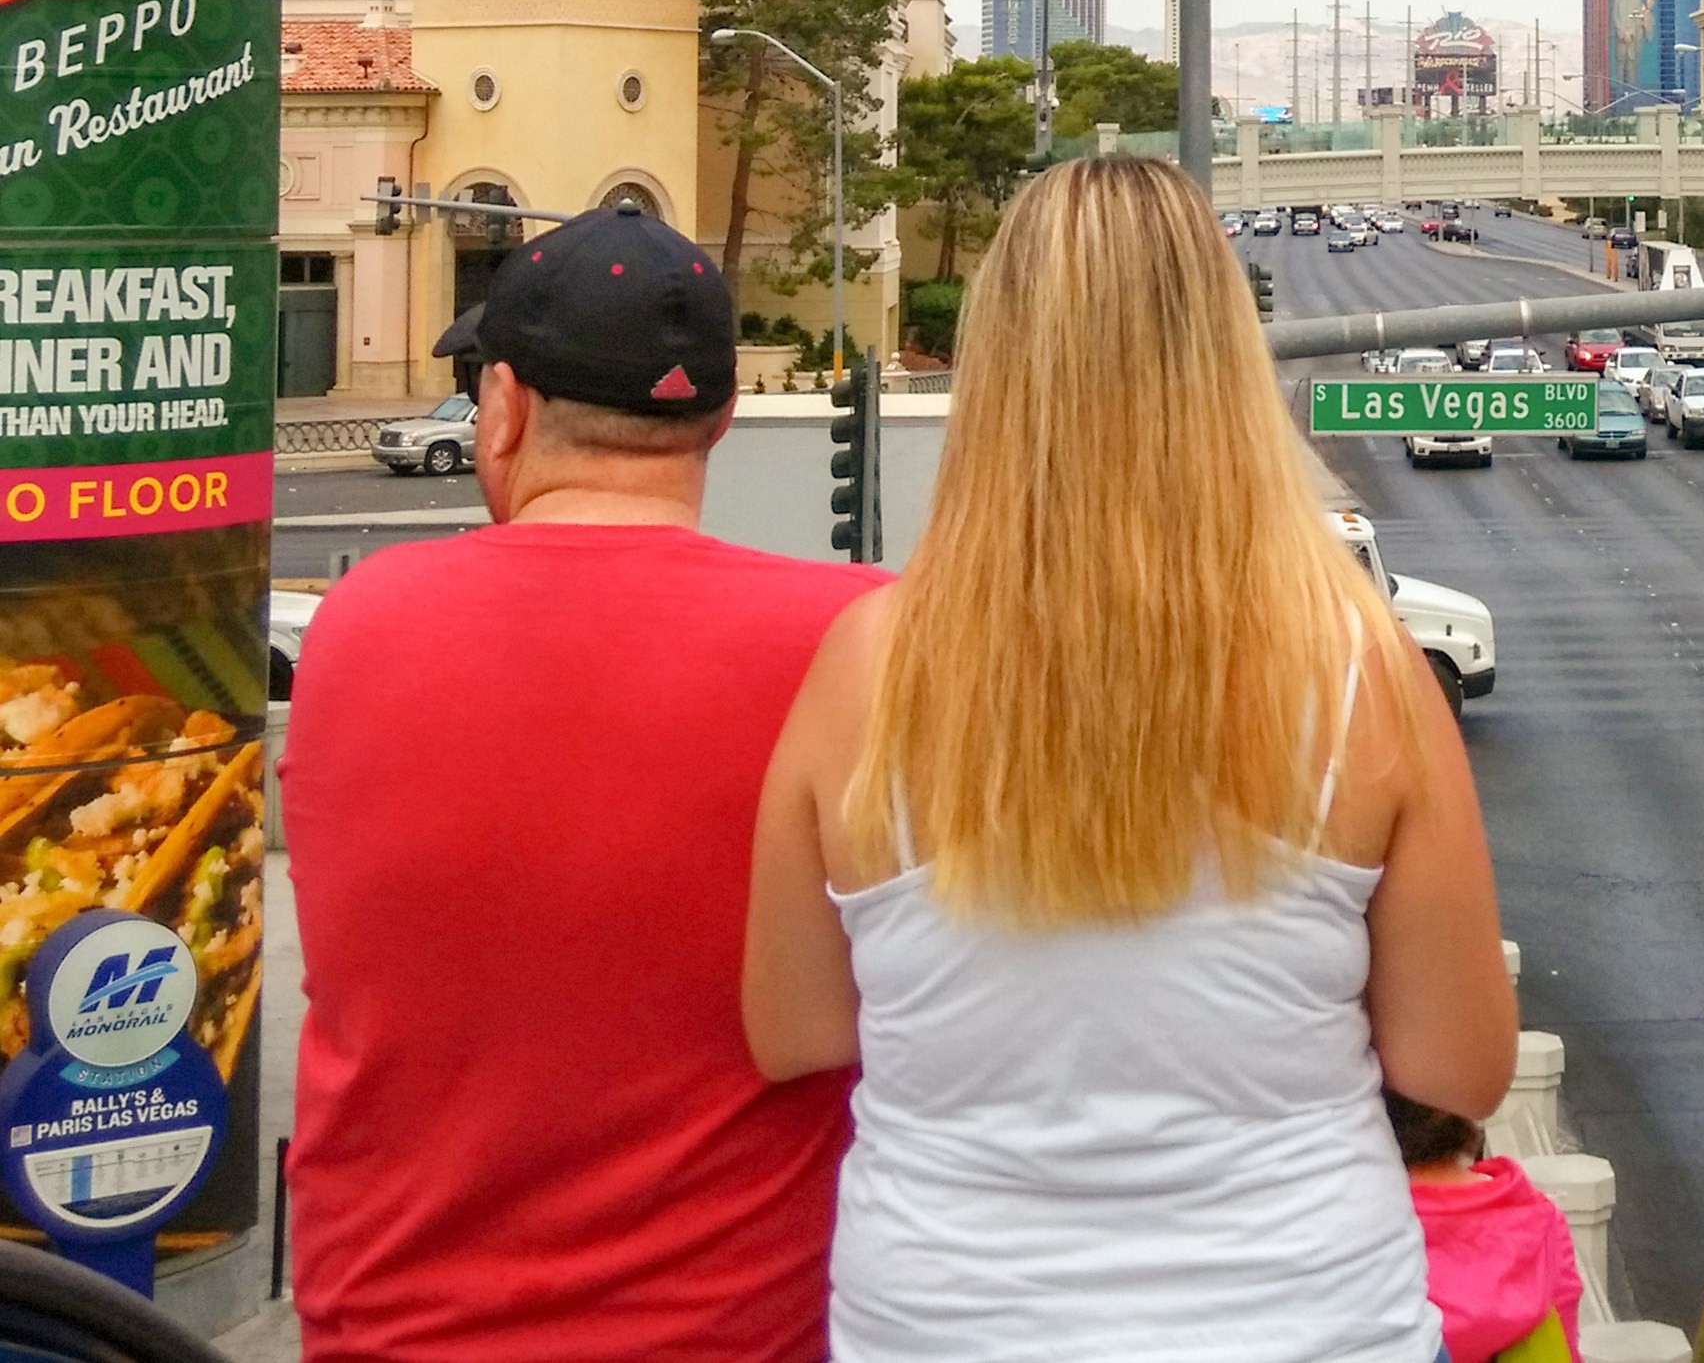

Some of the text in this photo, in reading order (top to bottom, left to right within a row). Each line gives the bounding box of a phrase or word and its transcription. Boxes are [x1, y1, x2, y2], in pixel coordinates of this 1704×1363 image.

[48, 41, 255, 157] Restaurant
[1466, 83, 1493, 92] TELLER
[133, 332, 231, 390] AND
[79, 402, 154, 435] YOUR
[161, 398, 229, 430] HEAD.
[1315, 384, 1588, 429] S Las Vegas BLVD
[1543, 412, 1588, 429] 3600
[70, 471, 229, 520] FLOOR
[66, 1012, 169, 1039] MONORAIL
[72, 1003, 174, 1027] LAS VEGAS
[77, 1057, 163, 1086] STATION
[71, 1087, 166, 1116] BALLY'S &
[36, 1099, 199, 1140] PARIS LAS VEGAS
